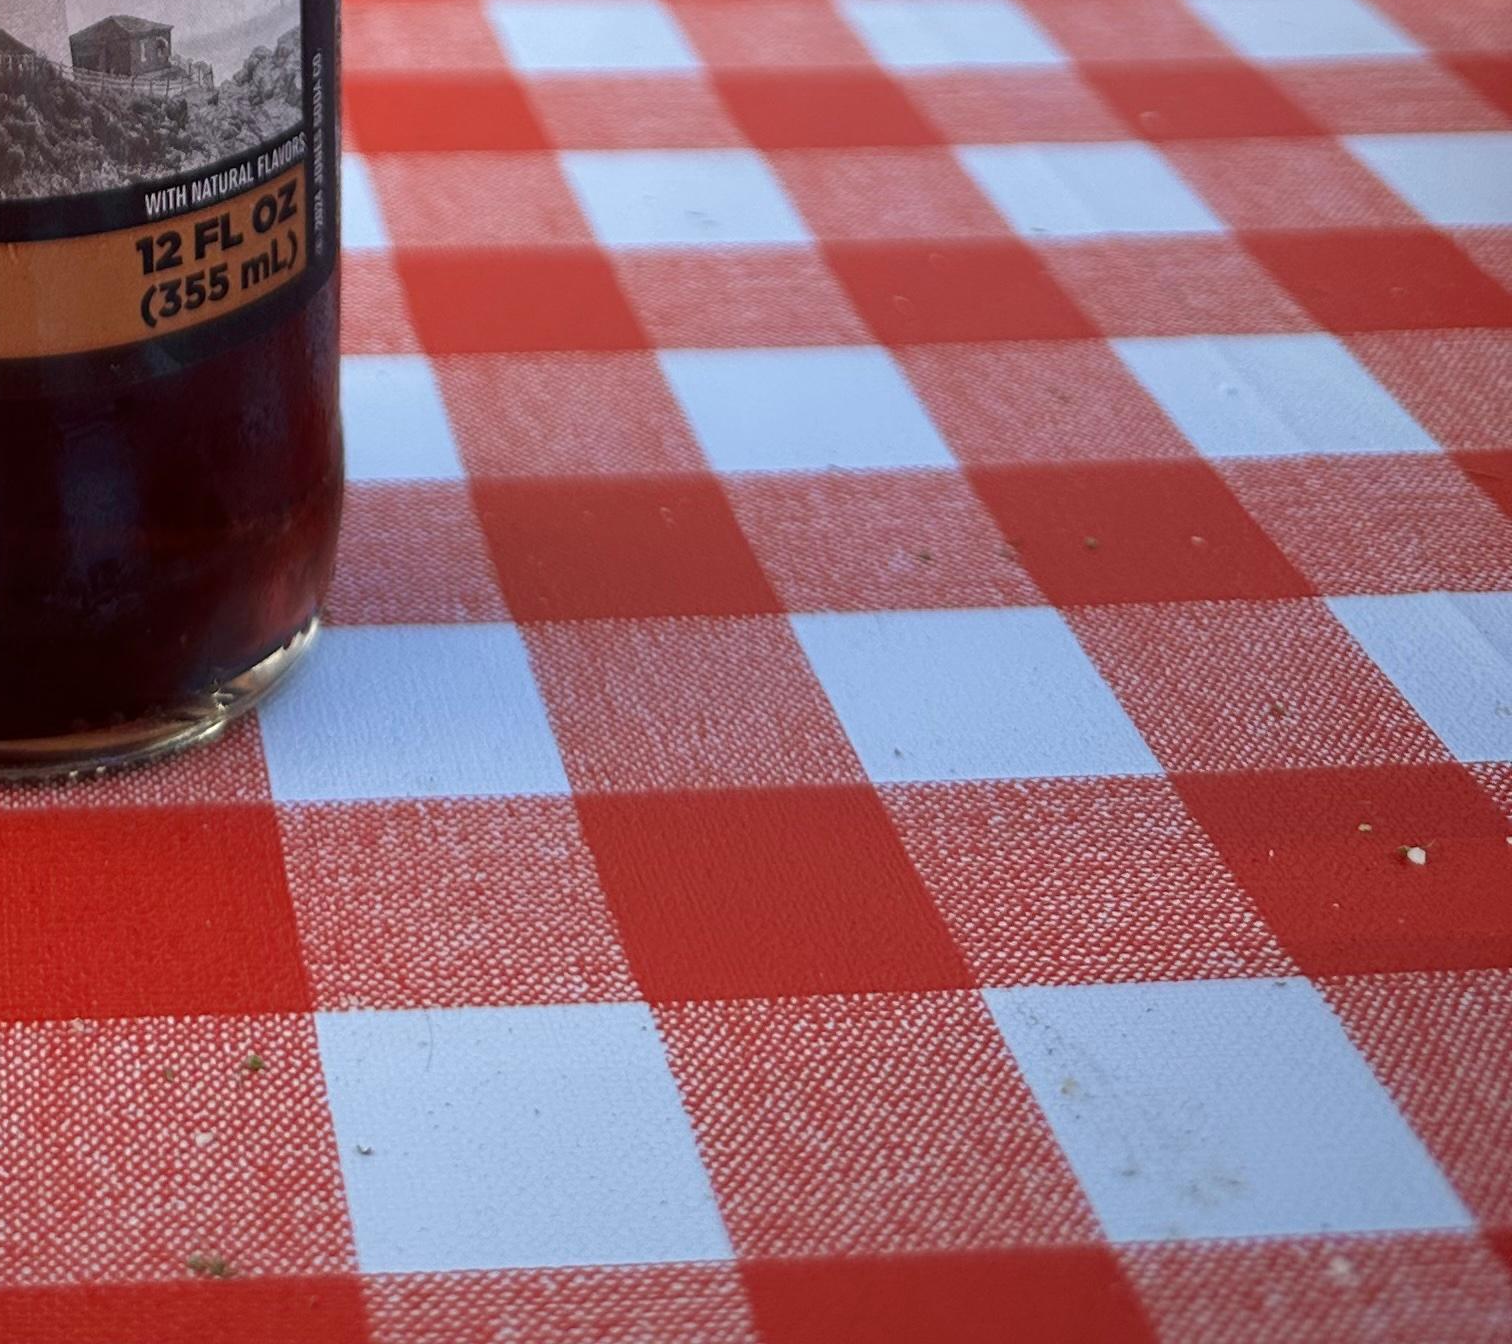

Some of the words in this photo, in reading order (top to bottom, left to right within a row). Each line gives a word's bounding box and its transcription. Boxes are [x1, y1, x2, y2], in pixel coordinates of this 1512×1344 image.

[144, 183, 187, 217] WITH
[191, 162, 255, 204] NATURAL
[256, 130, 308, 178] FLAVORS
[135, 230, 184, 276] 12
[194, 211, 244, 261] FL
[251, 177, 298, 235] OZ
[141, 263, 230, 329] (355
[240, 229, 299, 290] mL)
